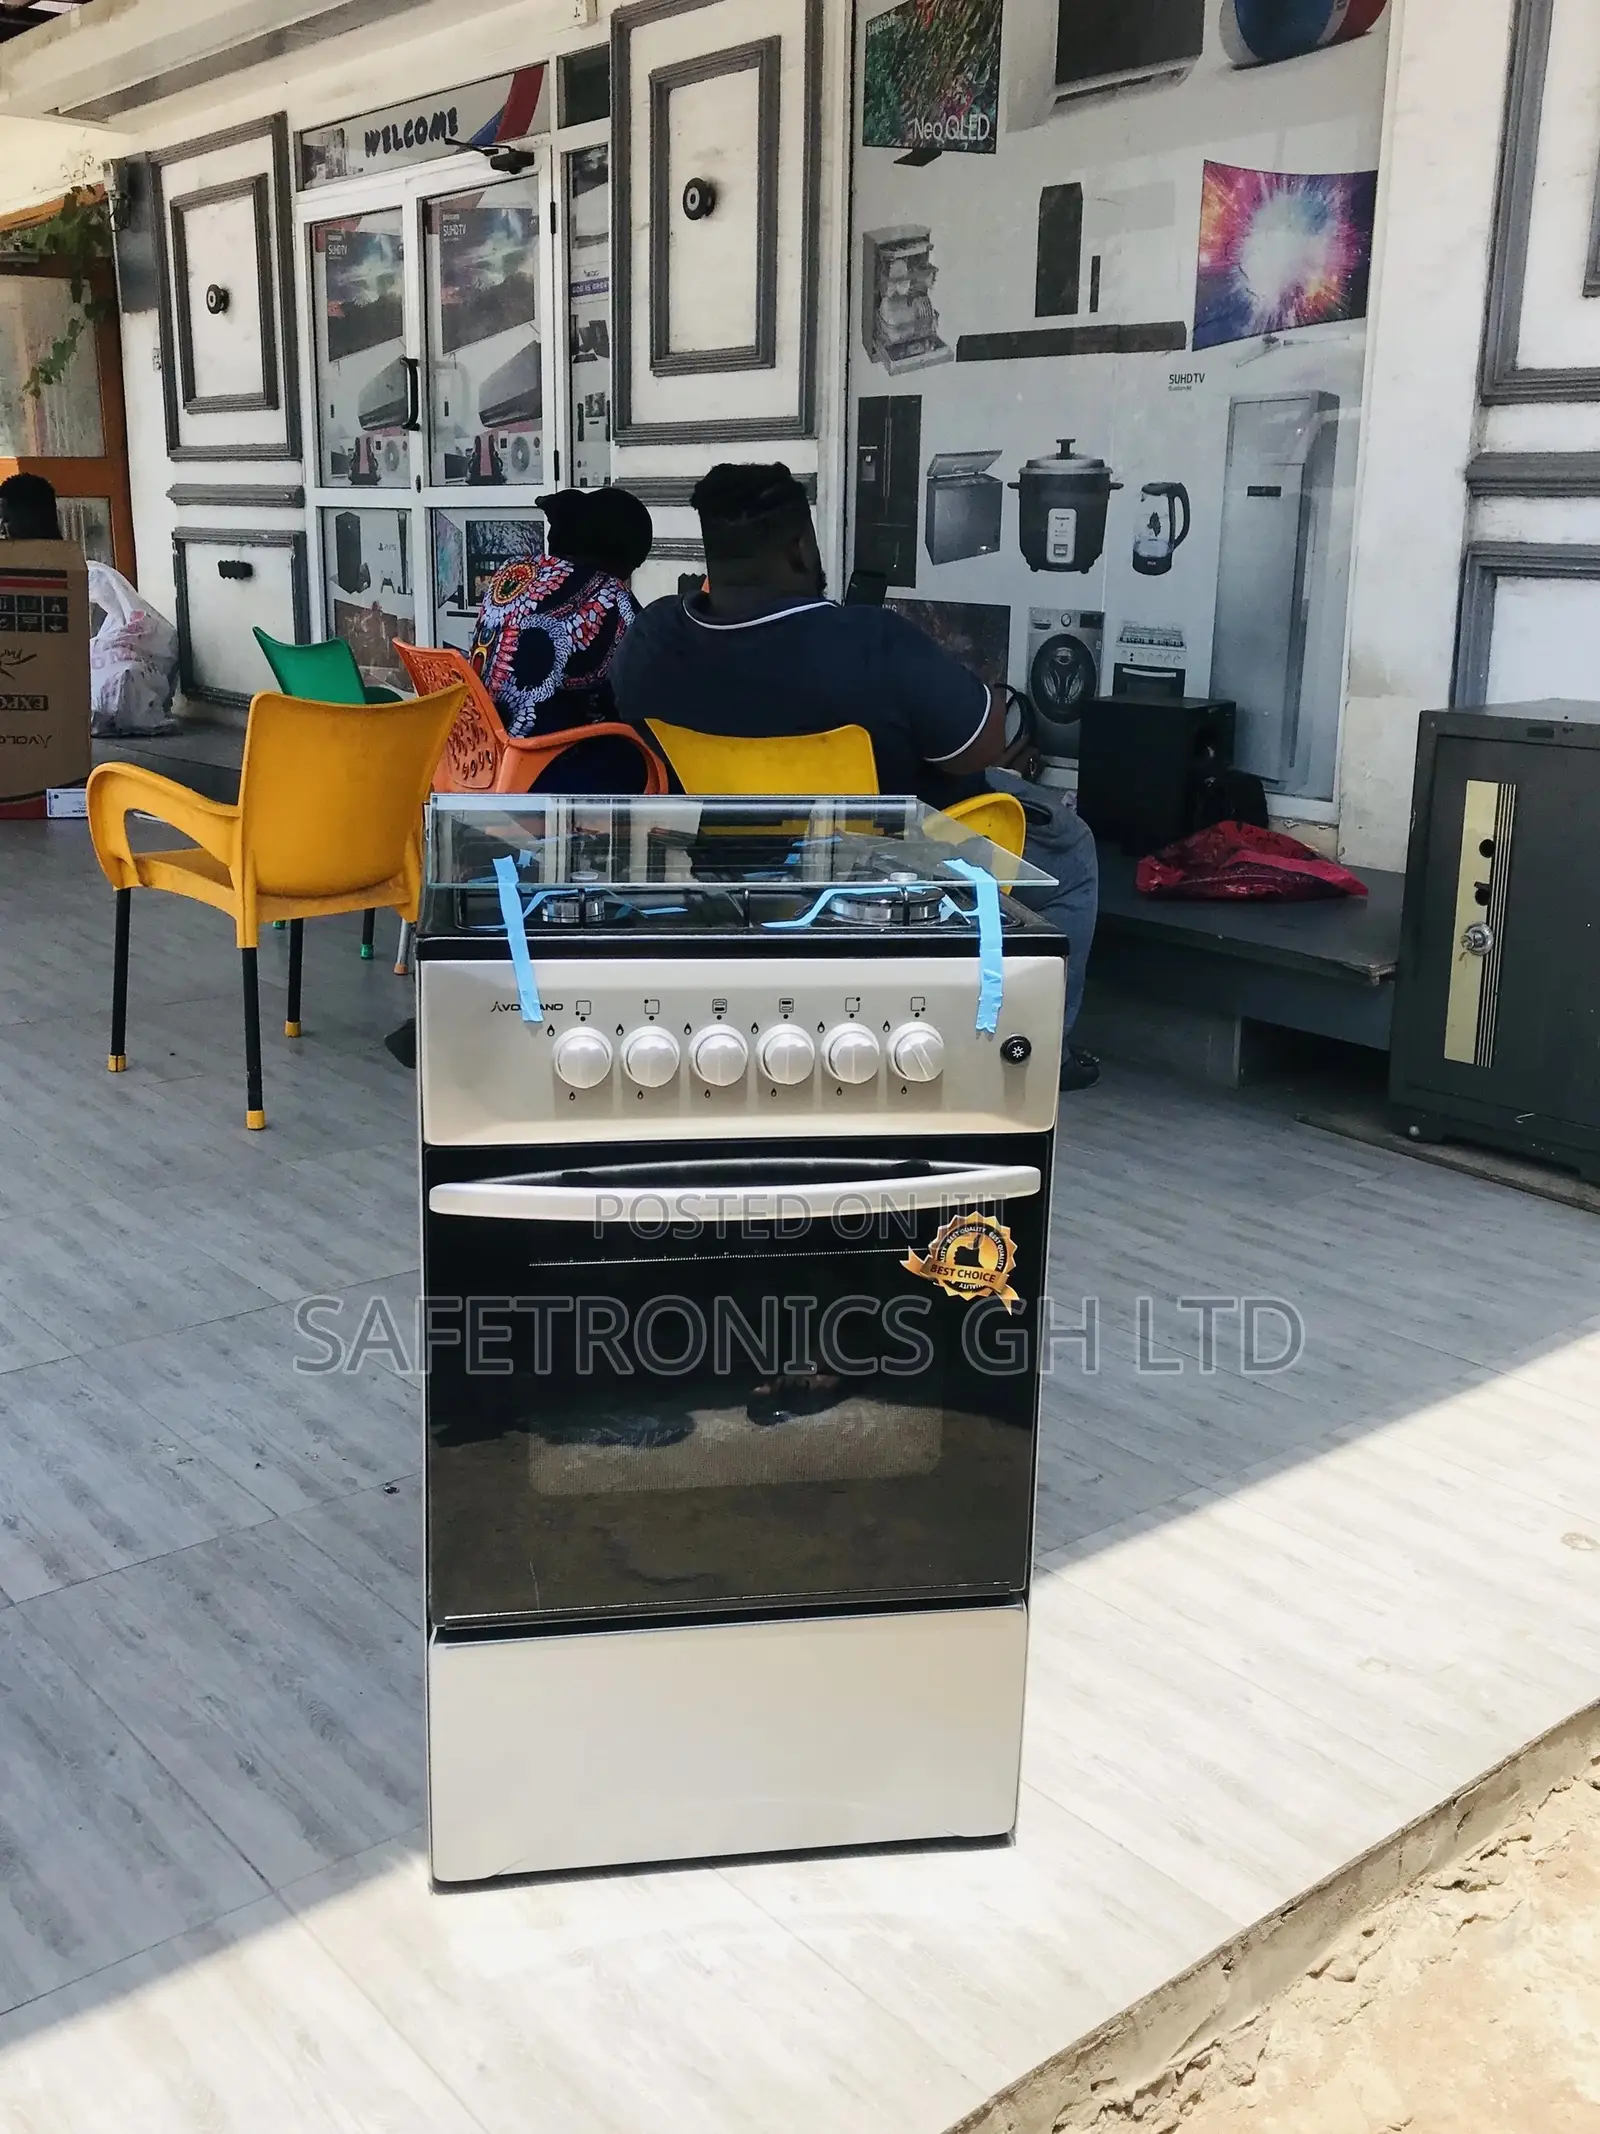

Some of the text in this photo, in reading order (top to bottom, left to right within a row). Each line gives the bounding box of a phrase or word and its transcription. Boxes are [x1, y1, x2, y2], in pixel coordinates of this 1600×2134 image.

[363, 106, 459, 158] WELCOME
[913, 113, 990, 141] Neo QLED
[930, 1263, 997, 1283] BEST CHOICE
